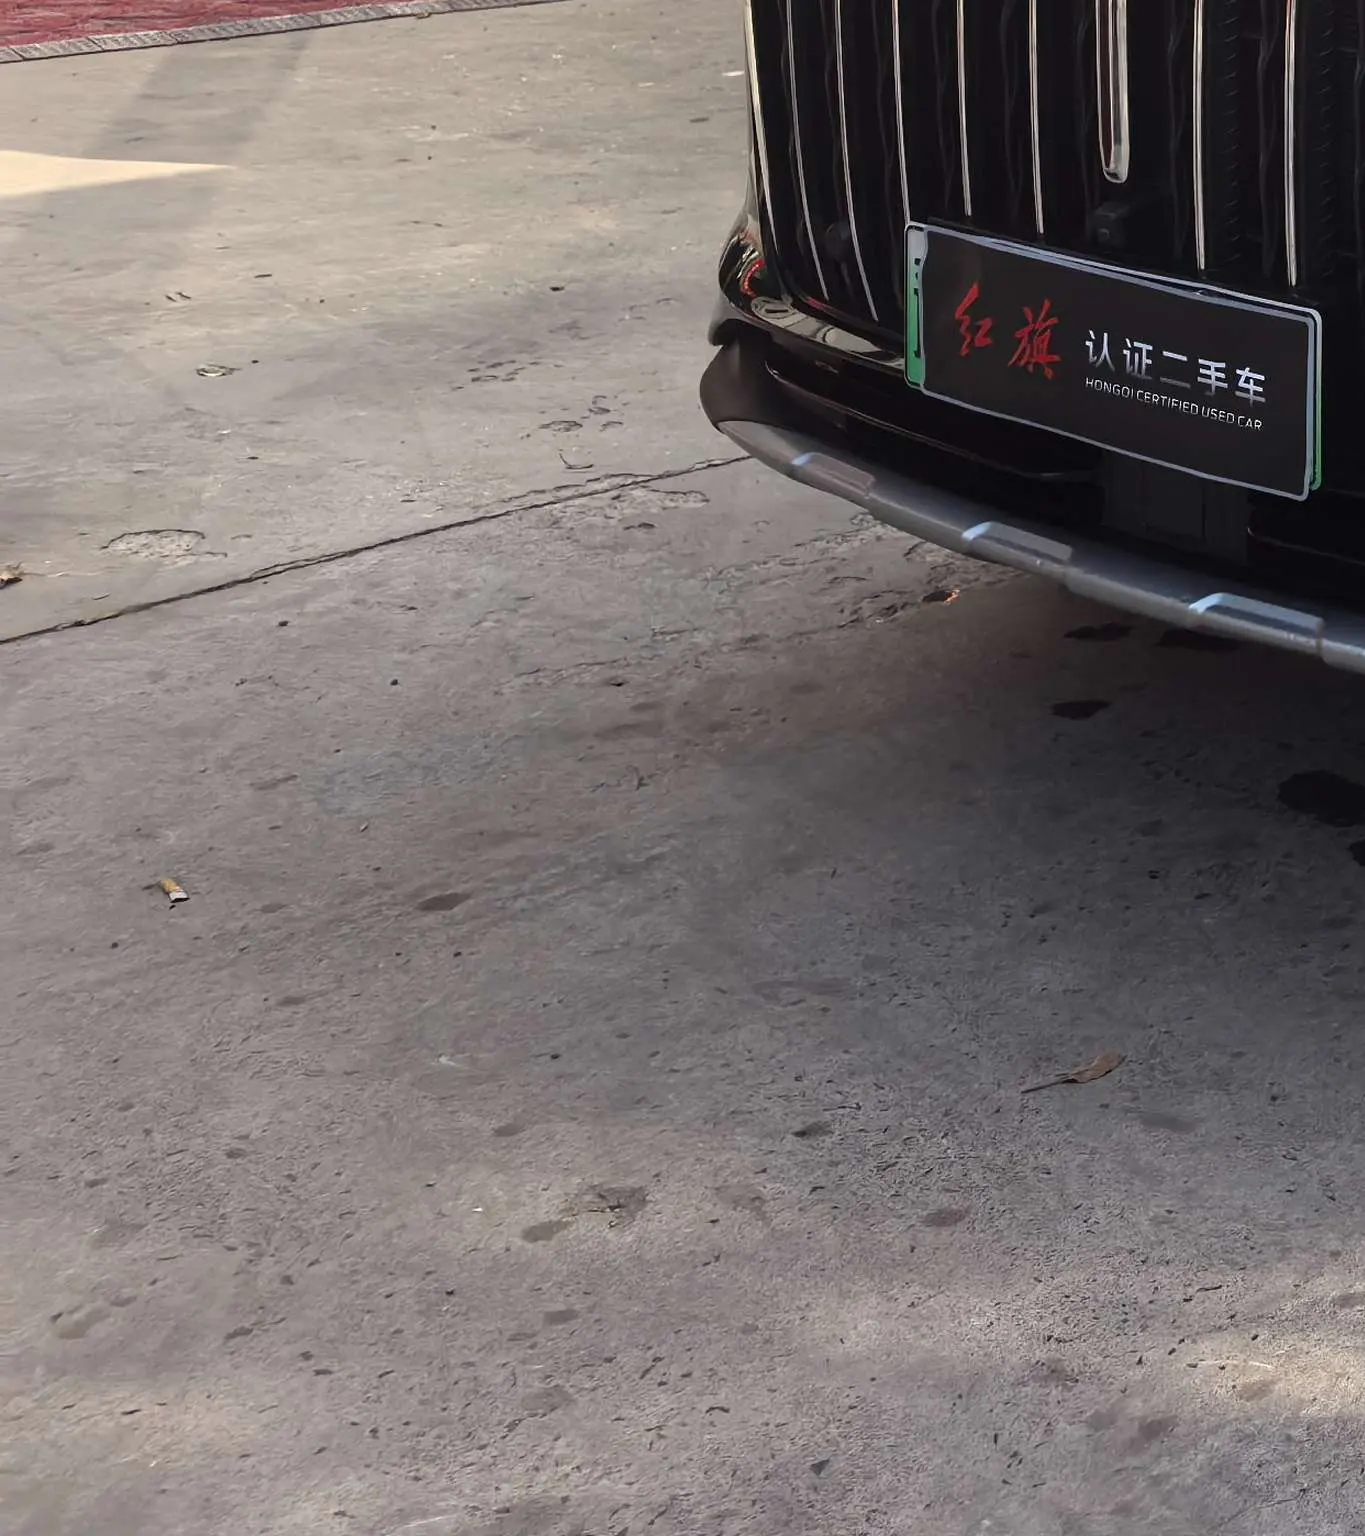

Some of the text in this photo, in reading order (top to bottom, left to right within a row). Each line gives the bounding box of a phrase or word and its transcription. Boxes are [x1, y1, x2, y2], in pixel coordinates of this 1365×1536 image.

[955, 282, 1266, 407] 红旗 认证二手车
[1136, 389, 1199, 415] CERTIFIED
[1201, 405, 1235, 424] USED
[1237, 415, 1263, 432] CAR
